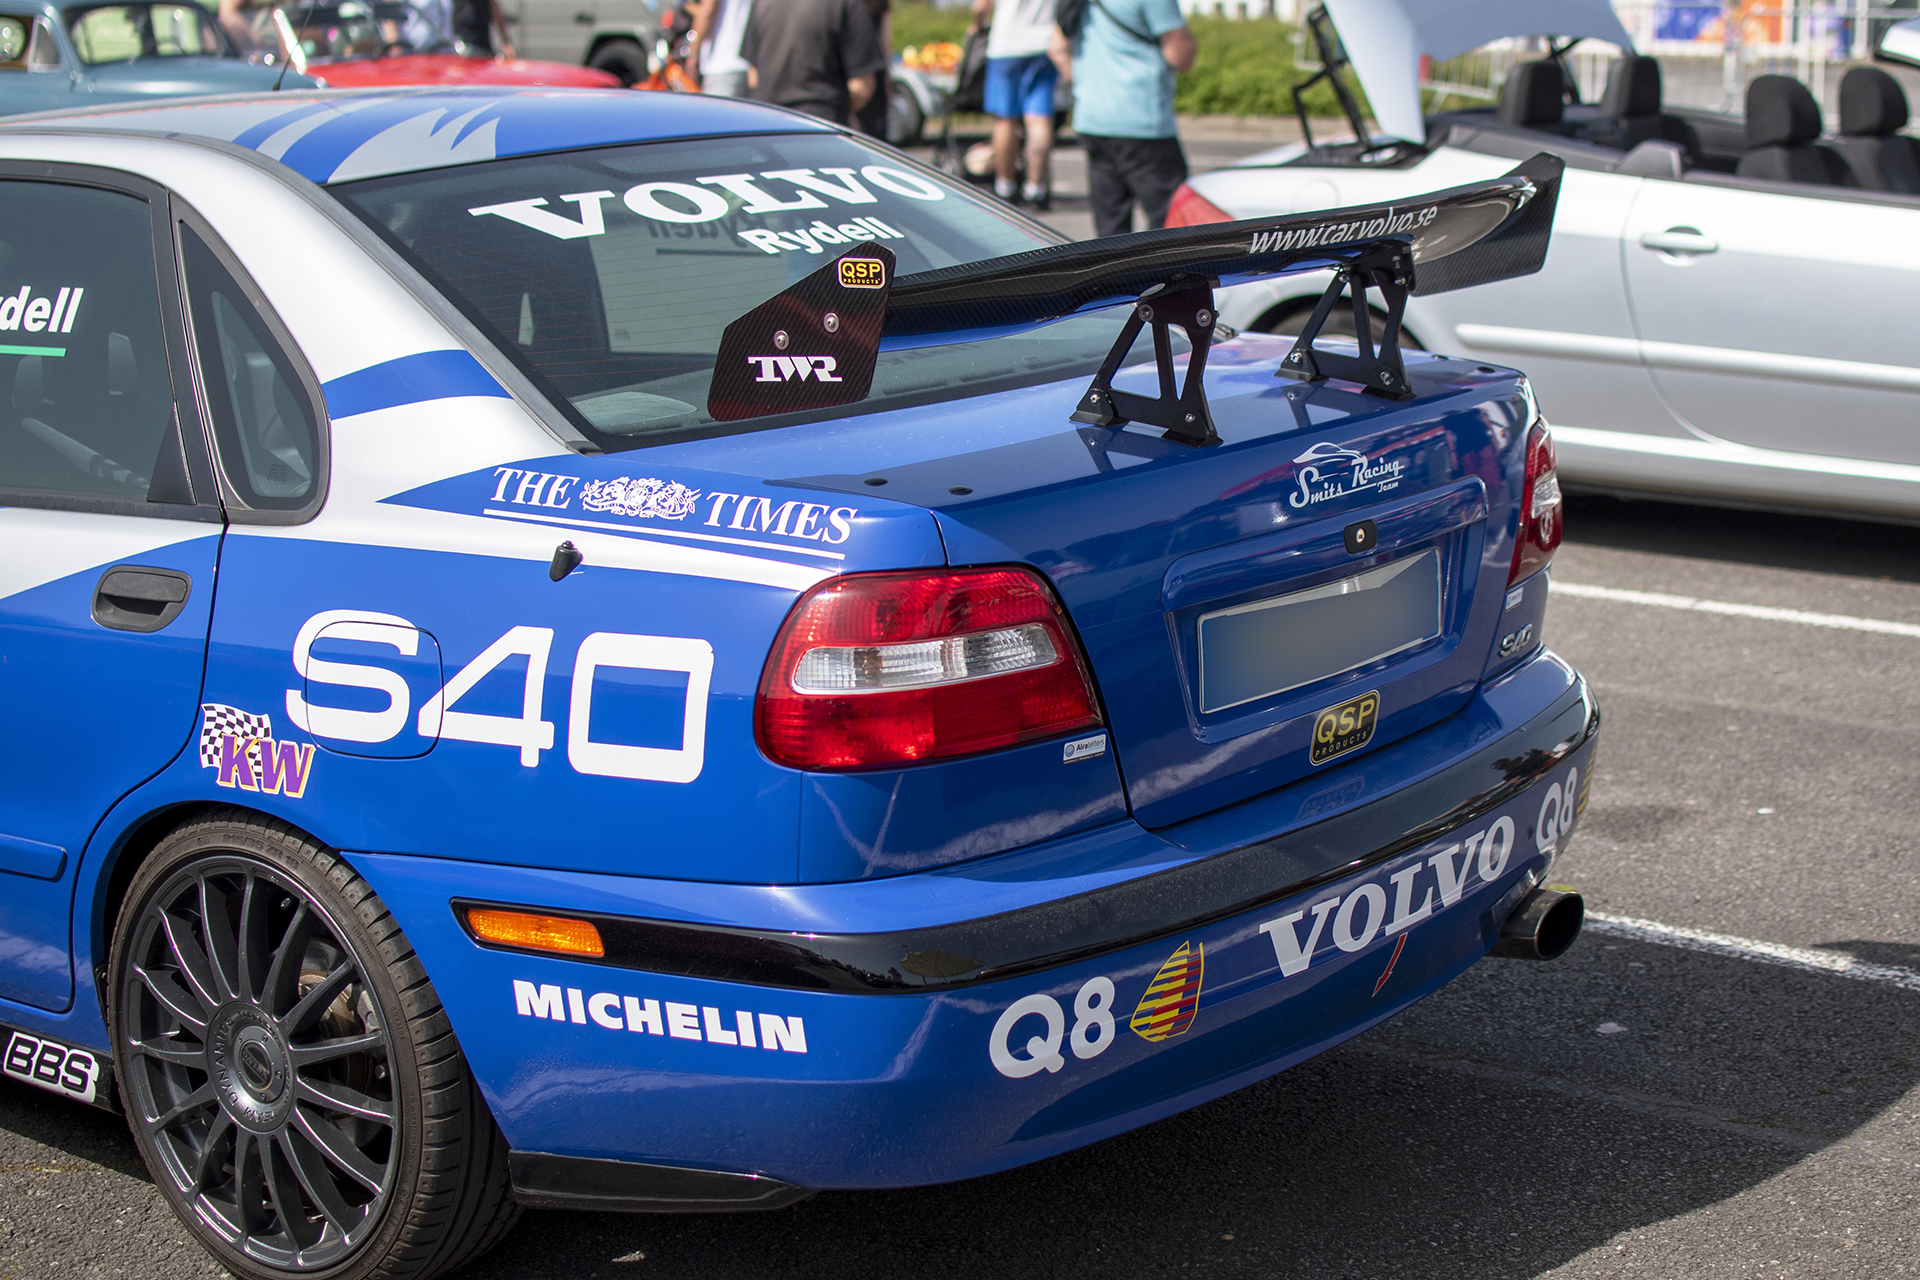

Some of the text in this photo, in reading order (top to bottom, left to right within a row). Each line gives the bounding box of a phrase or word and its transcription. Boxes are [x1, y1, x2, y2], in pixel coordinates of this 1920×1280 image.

[467, 165, 945, 240] VOLVO
[737, 217, 905, 254] Rydell
[1249, 206, 1438, 254] www.car.volvo.se
[842, 262, 881, 278] QSP
[0, 285, 84, 333] dell
[748, 356, 843, 382] TWR
[490, 467, 580, 510] THE
[704, 492, 859, 544] TIMES
[1289, 455, 1405, 508] Smits Racing
[1377, 481, 1399, 493] Team
[1499, 623, 1533, 657] S40
[285, 608, 715, 783] S40
[1317, 698, 1376, 744] QSP
[216, 732, 316, 799] KW
[1315, 731, 1368, 759] PRODUCTS
[1535, 768, 1578, 853] Q8
[1257, 815, 1516, 978] VOLVO
[513, 979, 808, 1053] MICHELIN
[988, 976, 1116, 1078] Q8
[4, 1032, 97, 1099] BBS
[214, 1016, 239, 1107] DYNAMICS
[243, 1106, 277, 1124] TEAM
